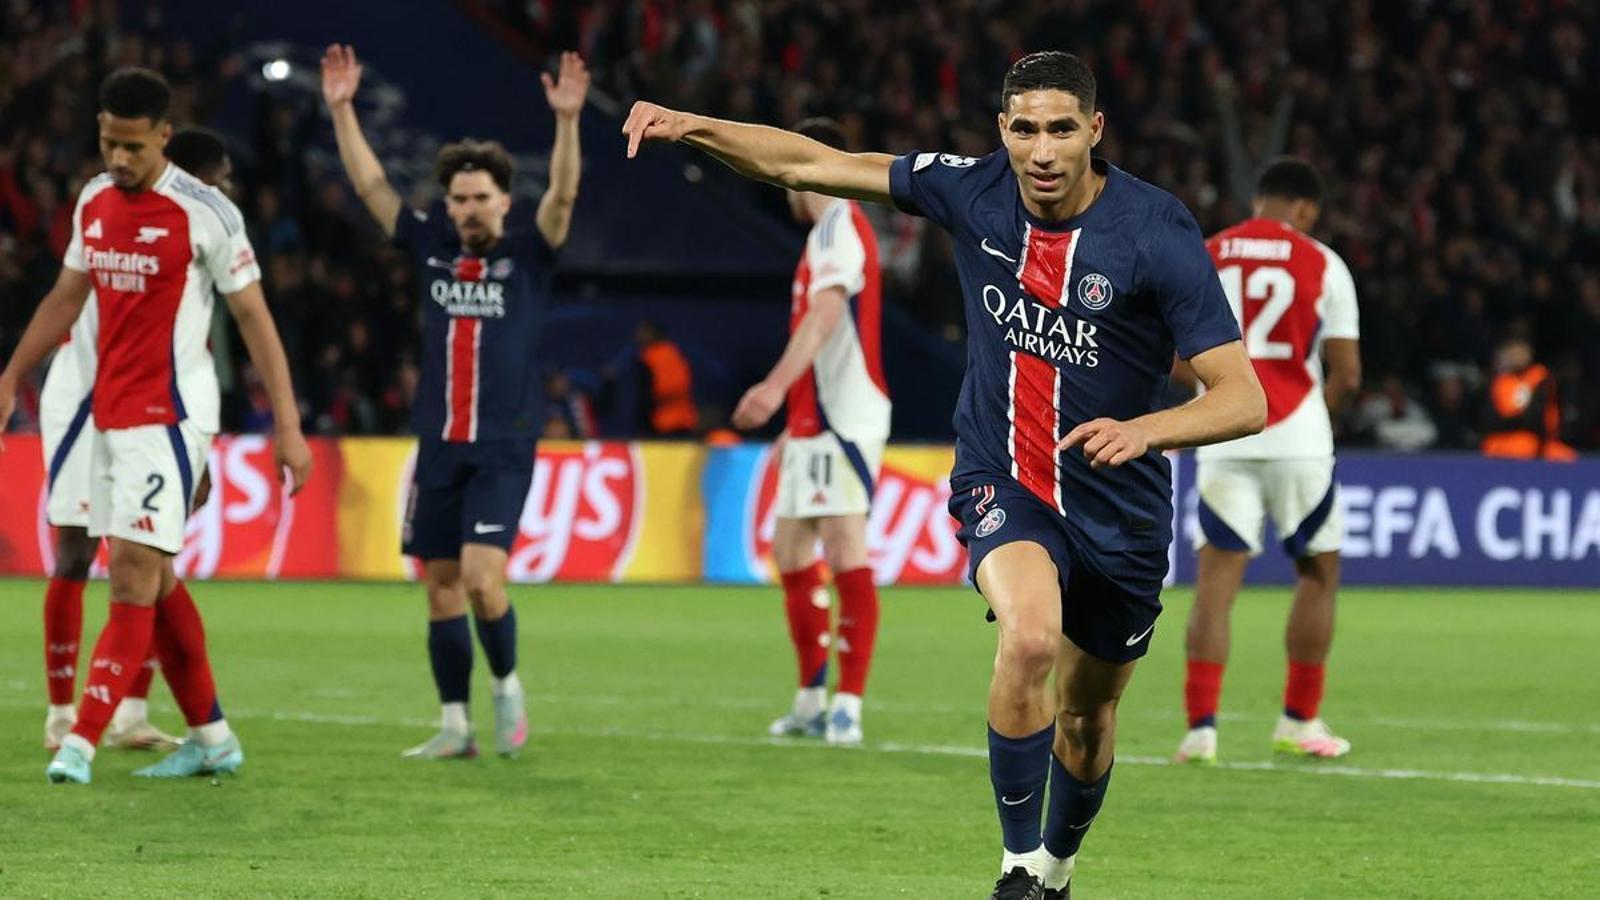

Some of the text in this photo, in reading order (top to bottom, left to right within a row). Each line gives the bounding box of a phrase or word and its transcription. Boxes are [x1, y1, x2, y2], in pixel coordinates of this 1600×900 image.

[85, 246, 160, 275] Emirates
[430, 280, 504, 306] QATAR
[1218, 265, 1296, 359] 12
[983, 284, 1098, 348] QATAR
[1004, 327, 1099, 367] AIRWAYS
[142, 473, 165, 512] 2
[1339, 485, 1461, 559] EFA
